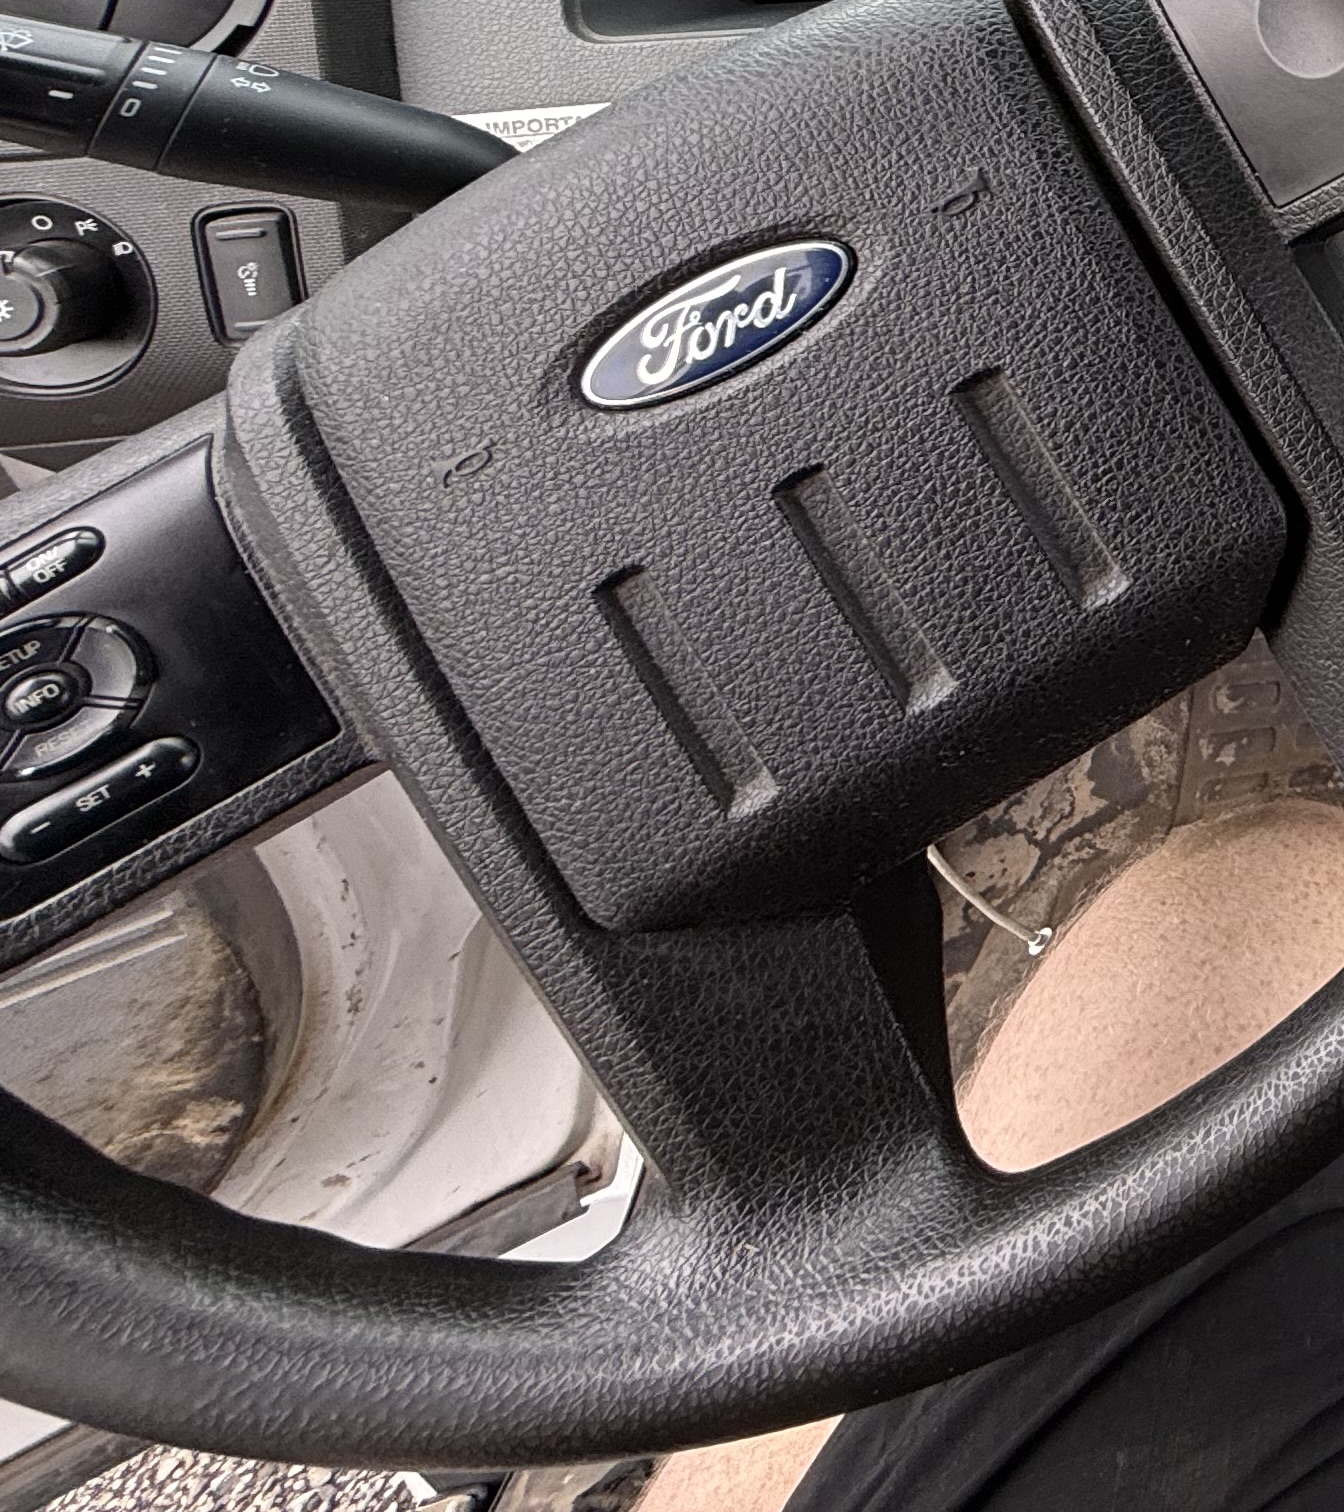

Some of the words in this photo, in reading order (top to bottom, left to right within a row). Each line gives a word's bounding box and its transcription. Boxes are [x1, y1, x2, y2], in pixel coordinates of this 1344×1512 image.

[485, 115, 582, 135] IMPORT
[636, 267, 797, 385] Ford
[33, 559, 67, 583] OFF
[0, 640, 41, 670] ETUP
[15, 683, 60, 713] INFO
[76, 785, 111, 812] SET
